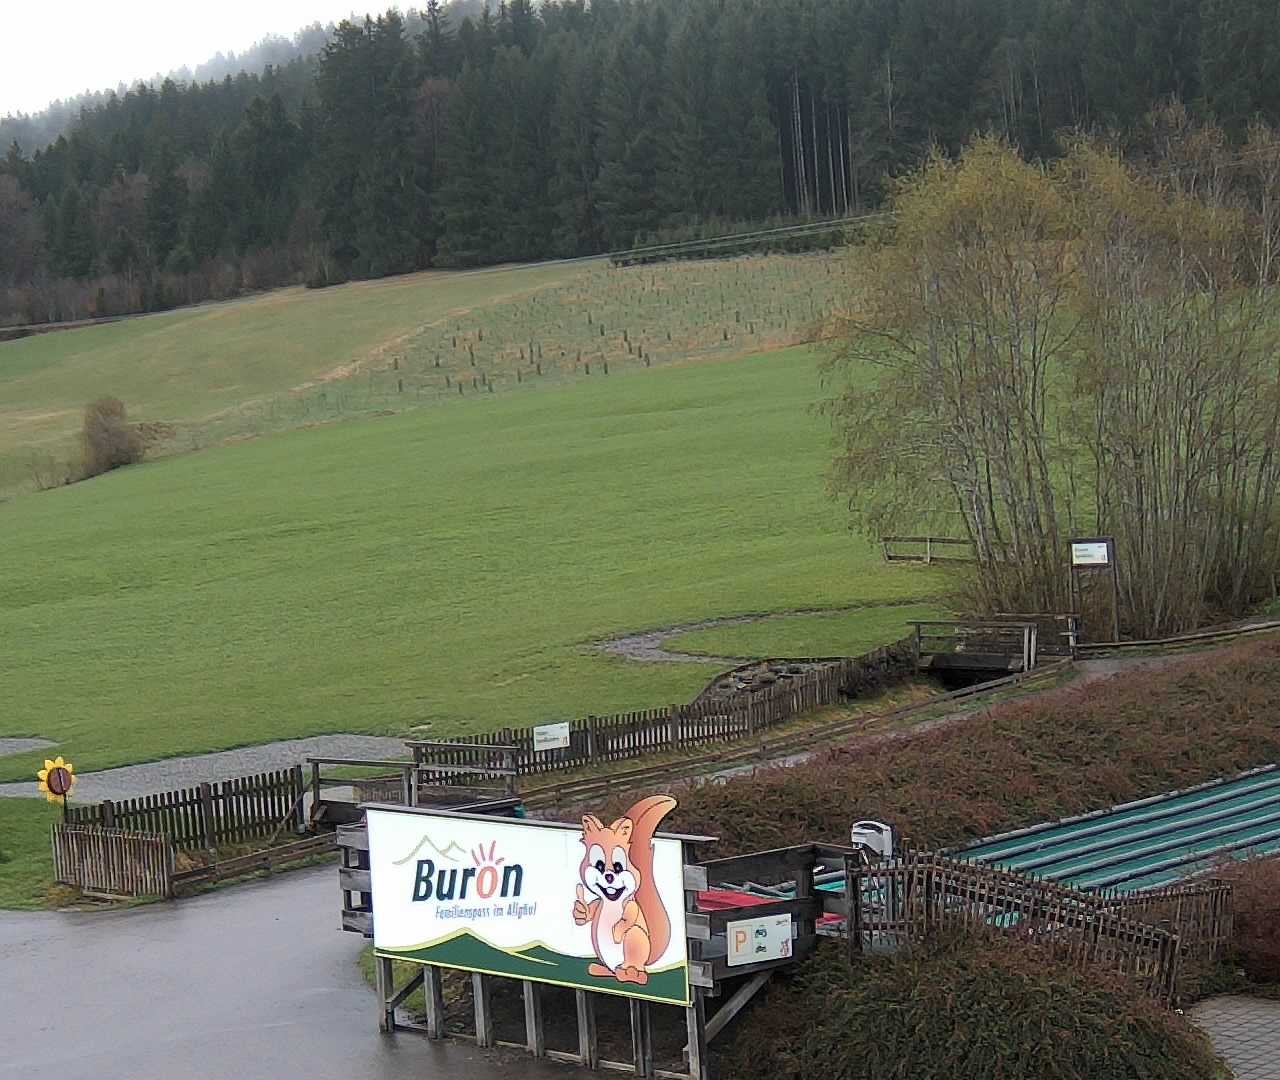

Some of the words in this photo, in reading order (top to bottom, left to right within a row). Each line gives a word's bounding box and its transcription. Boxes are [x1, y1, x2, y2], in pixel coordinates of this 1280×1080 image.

[412, 859, 523, 902] Buron
[493, 903, 504, 917] im
[735, 930, 747, 953] P
